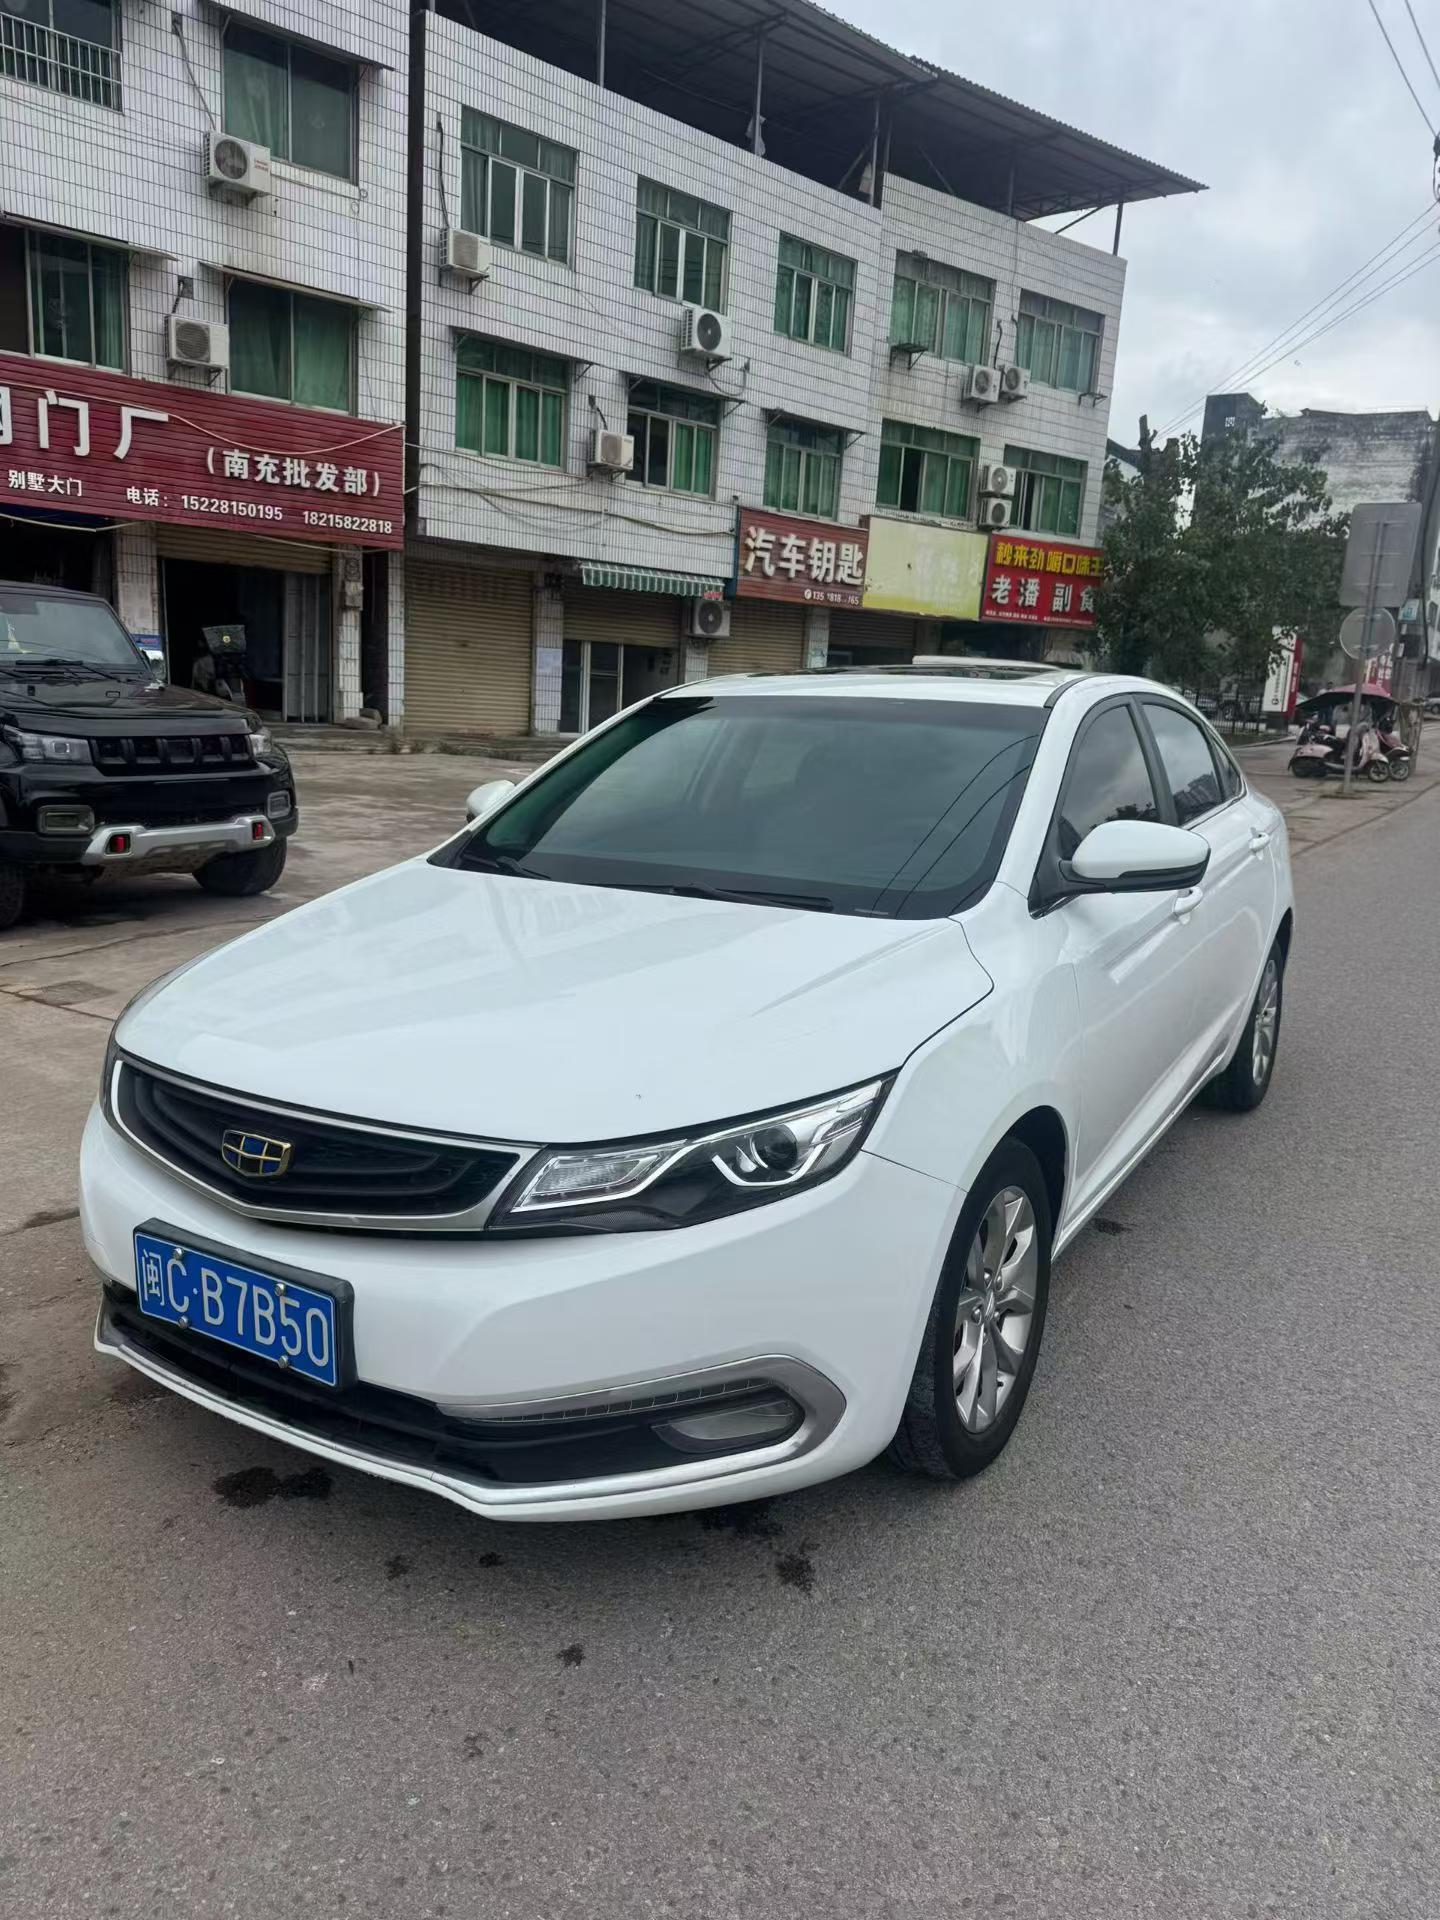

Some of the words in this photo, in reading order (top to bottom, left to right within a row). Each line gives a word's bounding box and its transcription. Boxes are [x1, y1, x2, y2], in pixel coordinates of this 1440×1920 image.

[0, 386, 169, 460] 门厂
[9, 470, 82, 497] 别墅大门
[181, 494, 283, 521] 15228150195
[303, 511, 393, 534] 18215822818
[745, 526, 864, 586] 汽车钥匙
